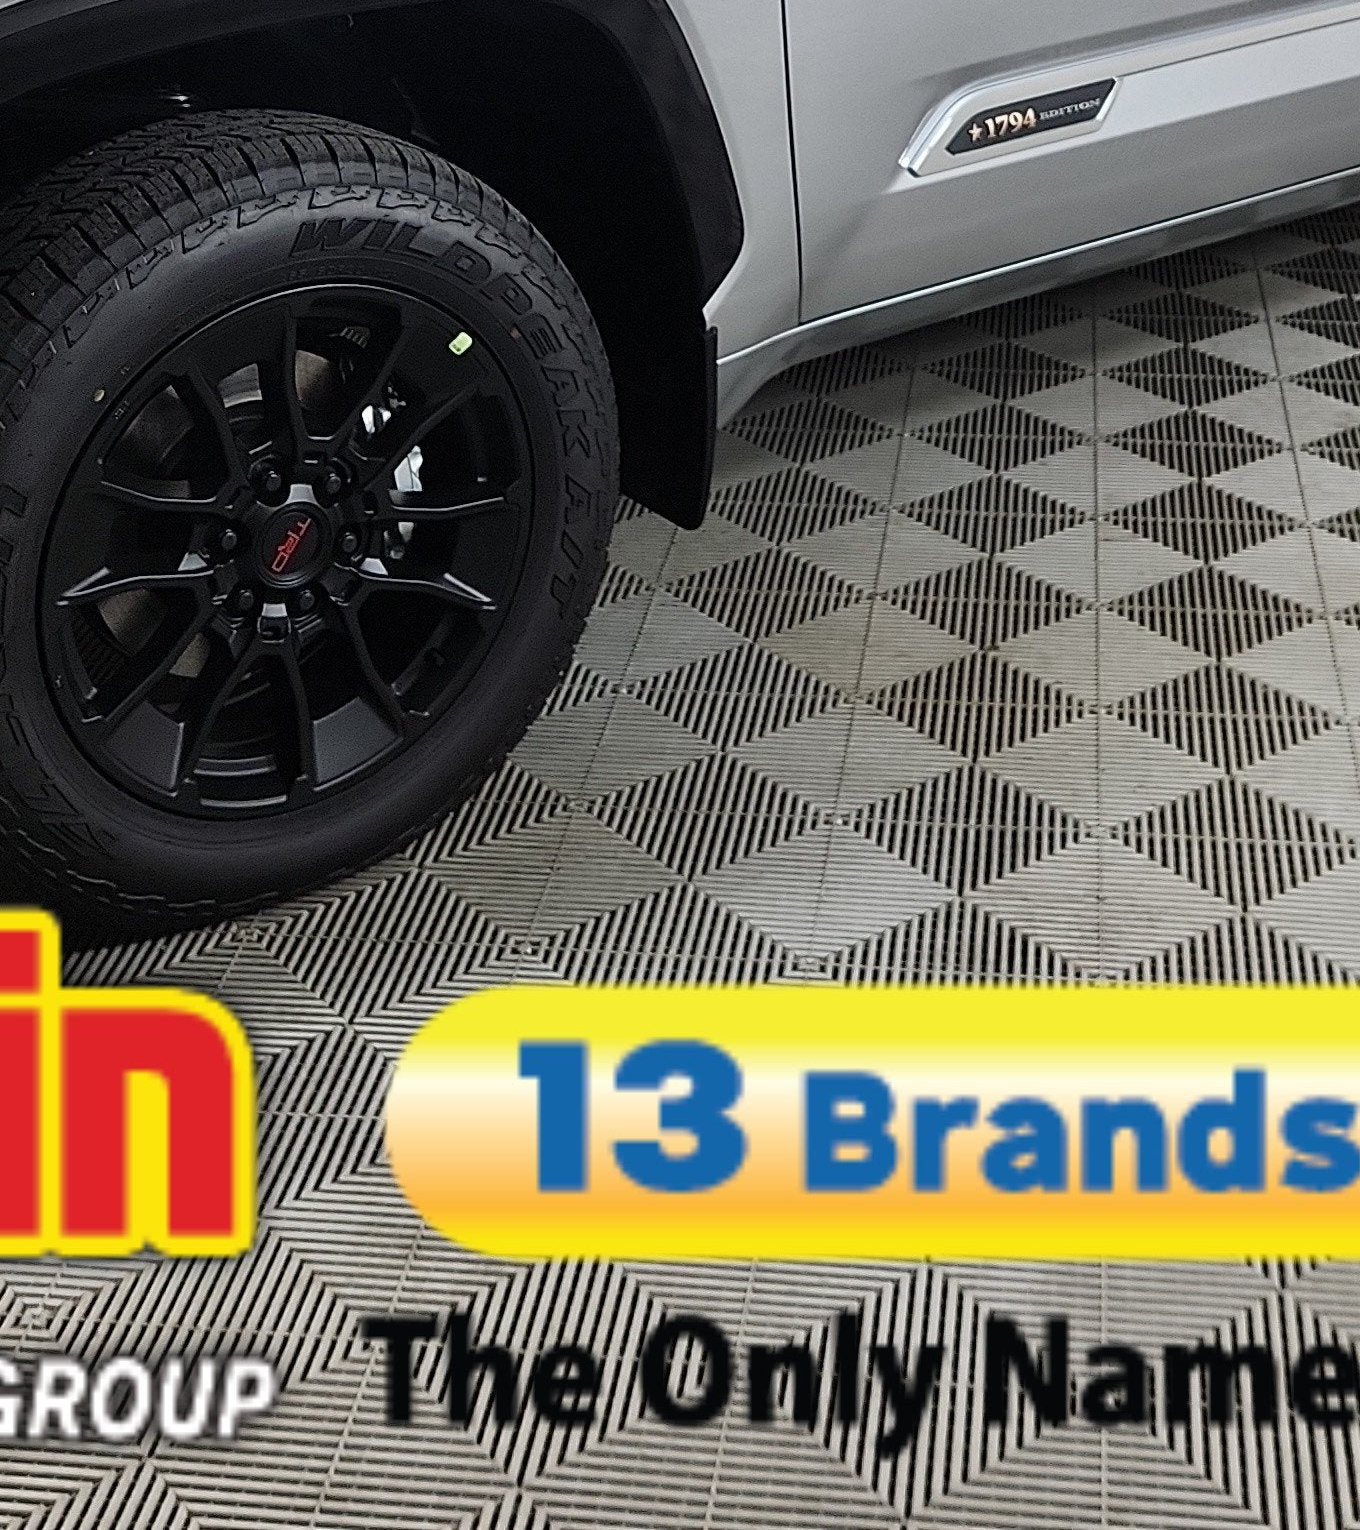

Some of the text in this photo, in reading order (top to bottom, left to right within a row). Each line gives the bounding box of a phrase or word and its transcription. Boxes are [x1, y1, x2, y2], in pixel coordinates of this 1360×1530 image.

[985, 98, 1101, 138] 1794 EDITION
[290, 217, 591, 461] WILDPEAK
[271, 517, 312, 573] TRD
